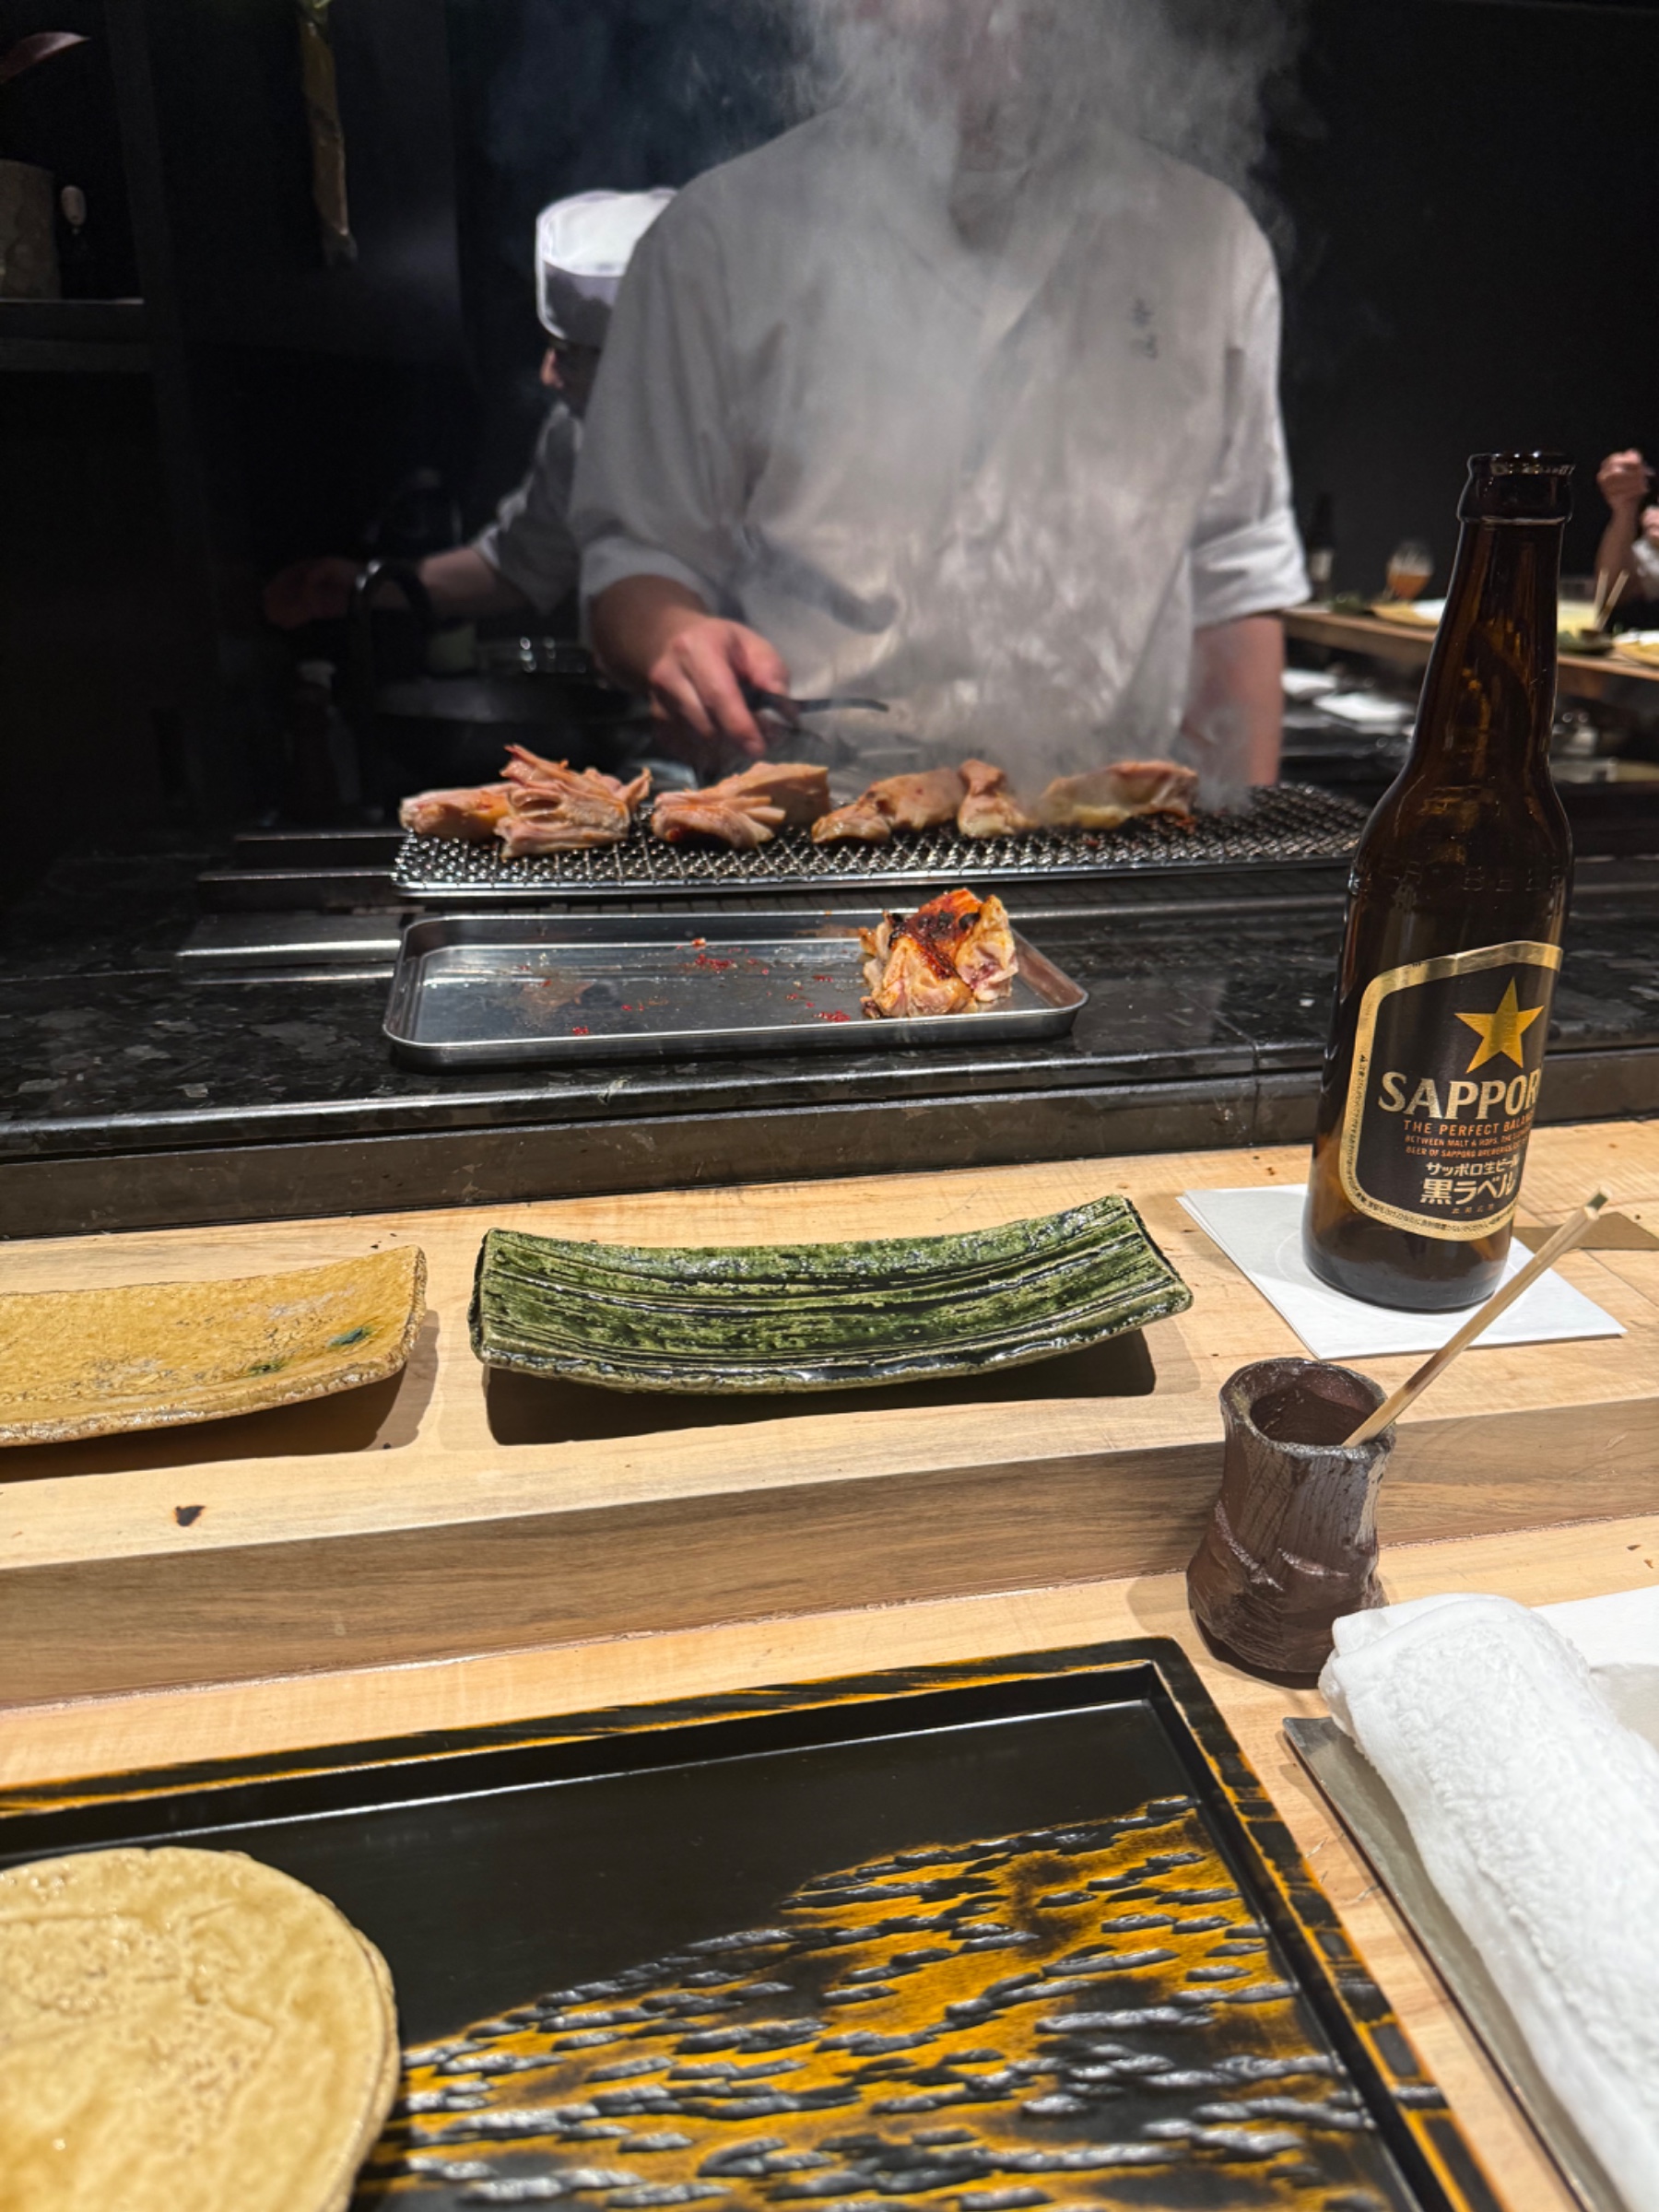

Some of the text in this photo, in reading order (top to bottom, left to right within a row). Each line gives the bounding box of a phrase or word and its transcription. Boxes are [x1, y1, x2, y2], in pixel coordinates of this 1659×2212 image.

[1403, 1120, 1433, 1134] THE
[1439, 1122, 1500, 1136] PERFECT
[1405, 1135, 1444, 1147] BETWEEN
[1447, 1139, 1469, 1148] MALT
[1429, 1148, 1440, 1157] OF
[1419, 1171, 1515, 1206] 黒ラベル
